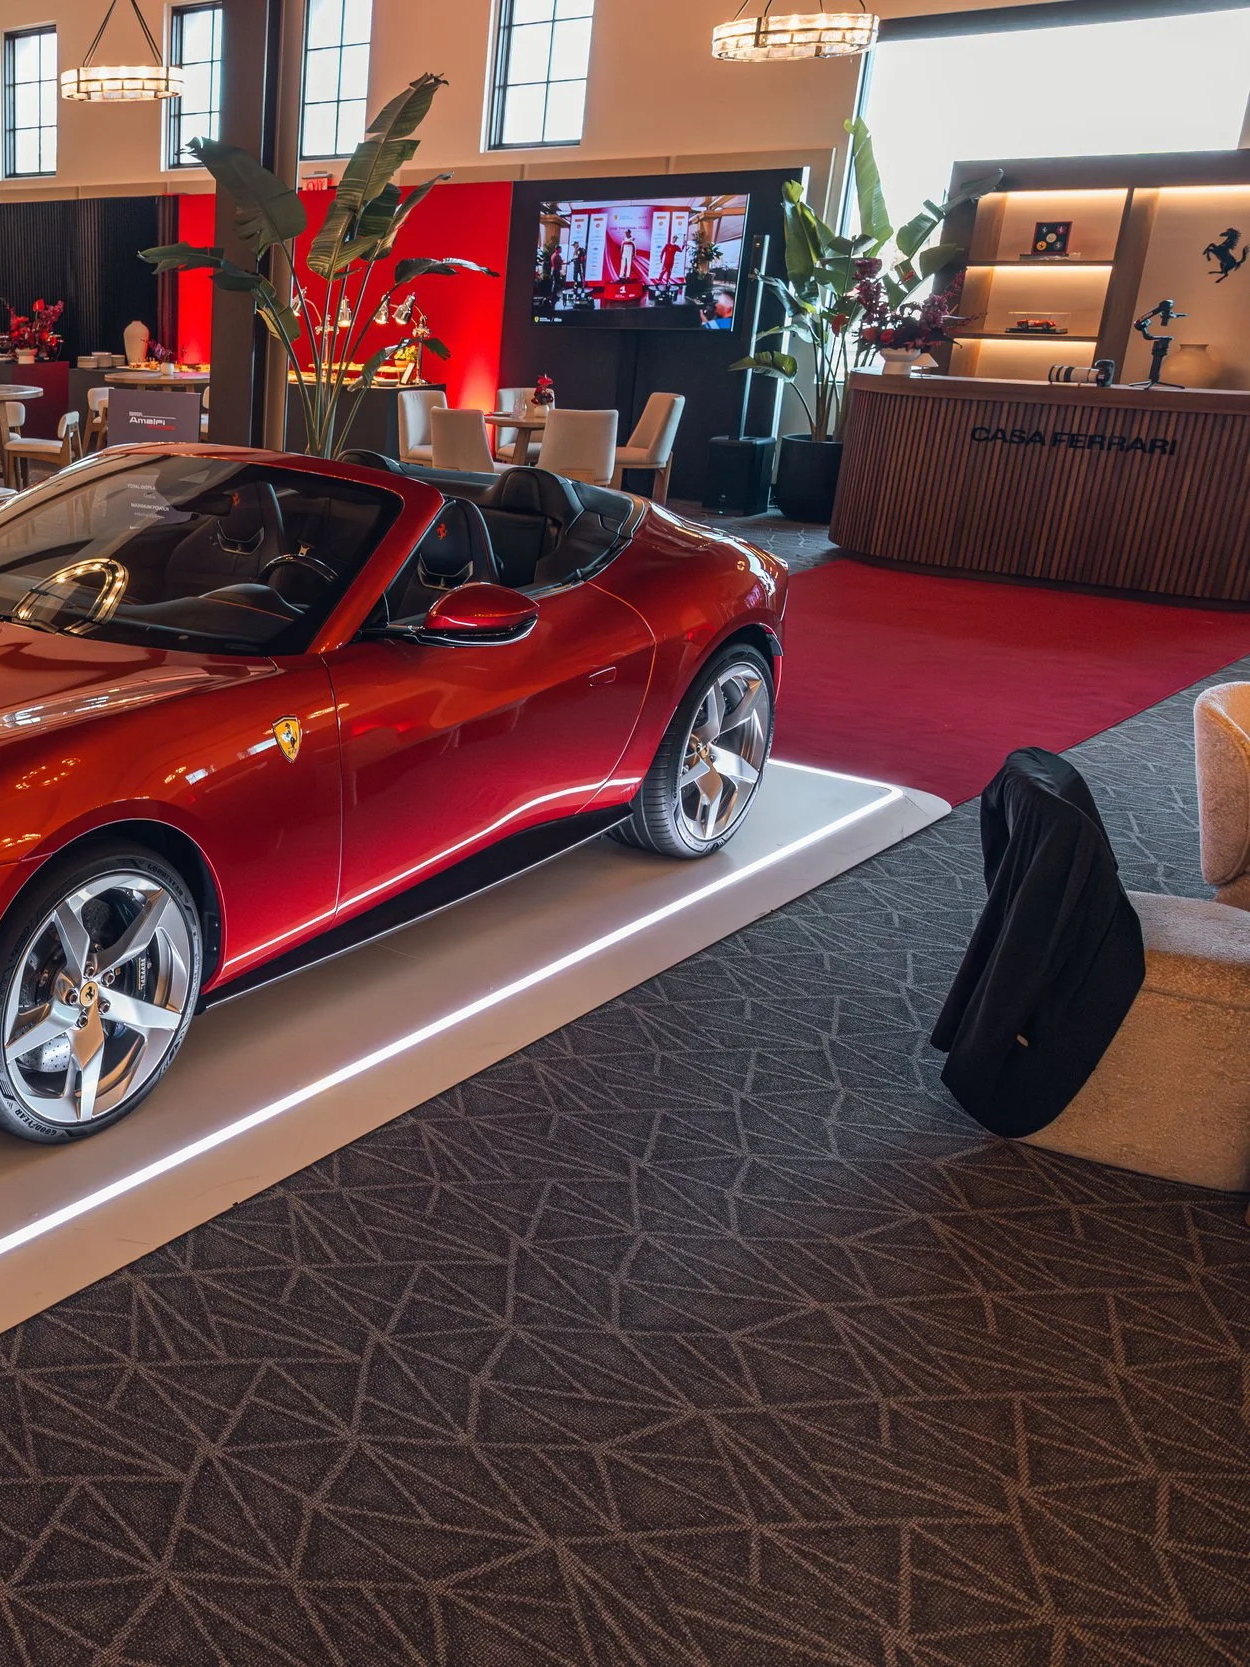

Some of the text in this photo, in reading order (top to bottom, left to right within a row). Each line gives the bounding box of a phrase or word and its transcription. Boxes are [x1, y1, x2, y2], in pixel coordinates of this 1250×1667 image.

[971, 426, 1178, 456] CASA FERRARI
[14, 1108, 57, 1136] GOODYEAR
